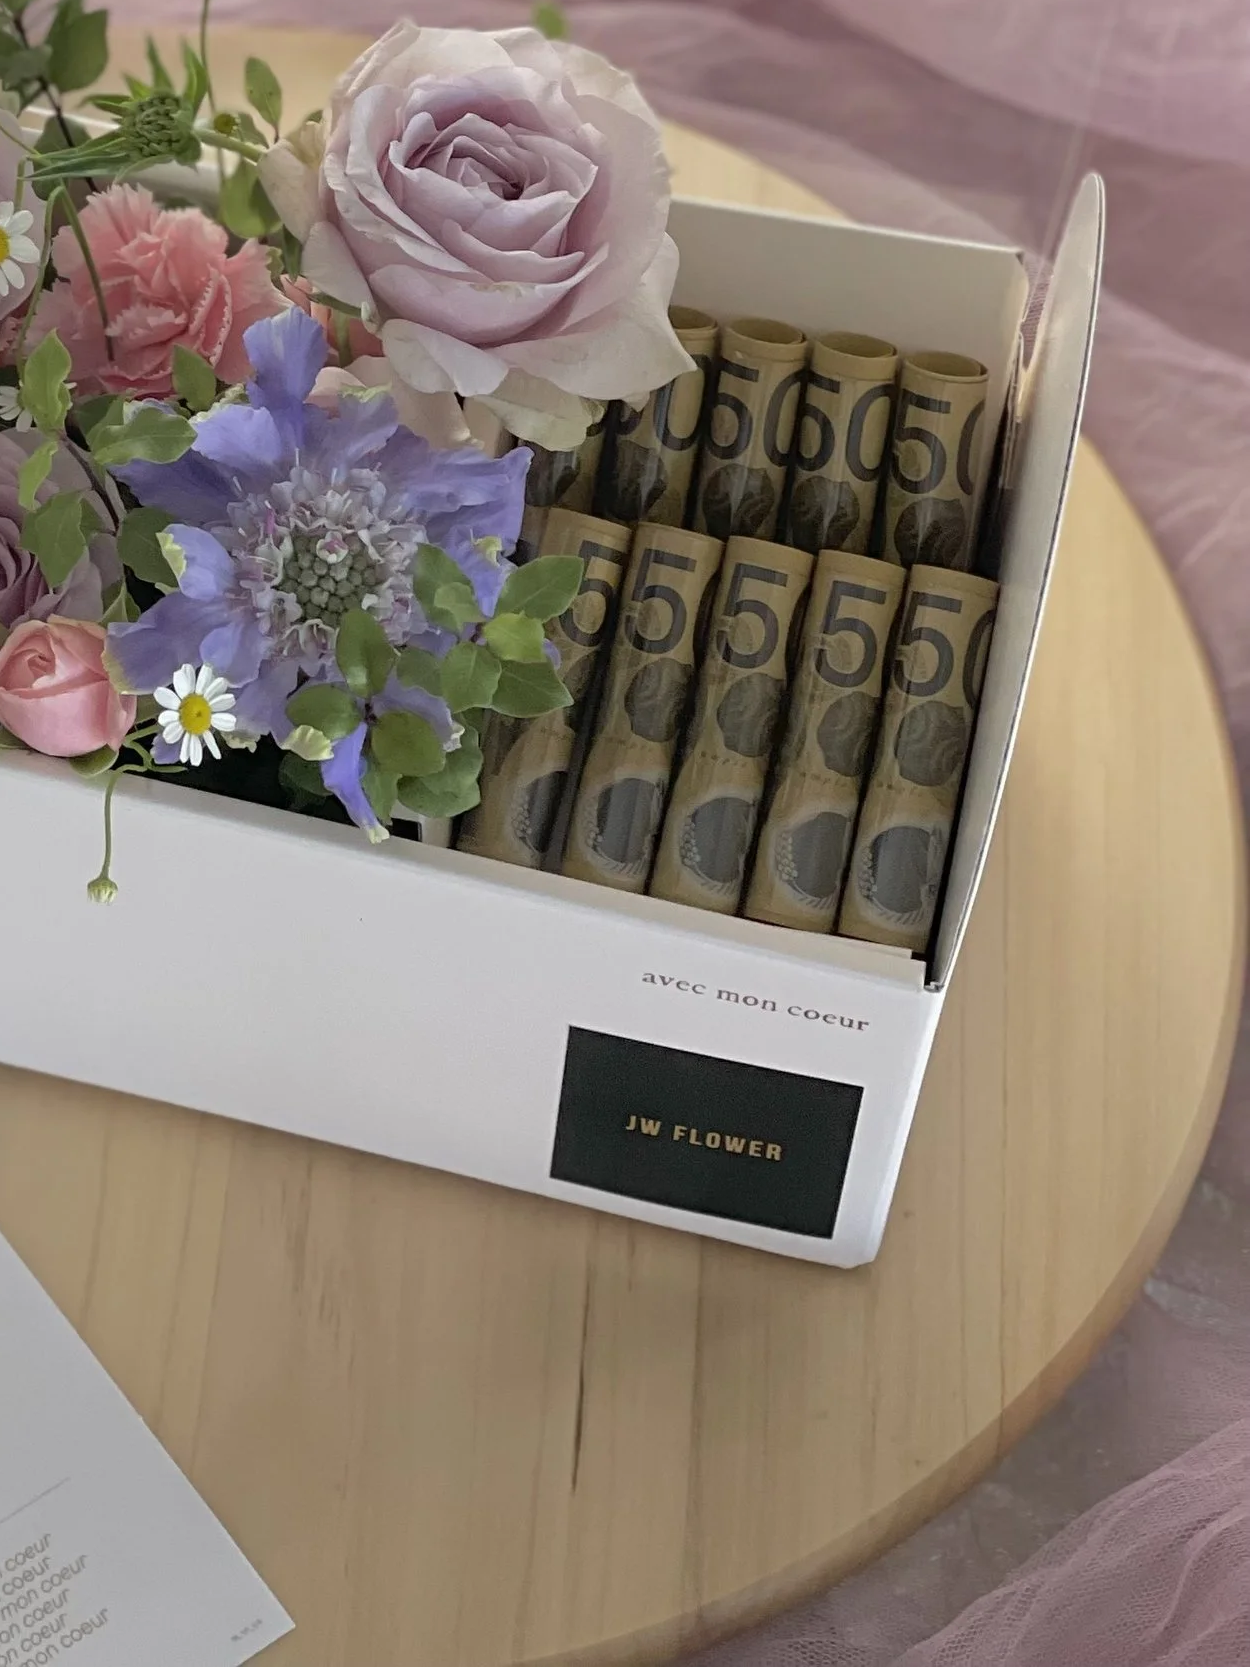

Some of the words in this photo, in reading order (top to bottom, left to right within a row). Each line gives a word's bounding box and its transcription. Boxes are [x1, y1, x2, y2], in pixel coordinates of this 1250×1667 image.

[642, 970, 707, 996] avec
[716, 987, 778, 1013] mon
[786, 1003, 871, 1032] coeur
[625, 1115, 662, 1137] JW
[672, 1124, 784, 1162] FLOWER
[4, 1533, 52, 1572] coeur
[0, 1588, 39, 1621] mon
[40, 1554, 88, 1594] coeur
[2, 1556, 51, 1596] coeur
[23, 1588, 70, 1628] coeur
[60, 1607, 110, 1649] coeur
[20, 1613, 69, 1653] coeur
